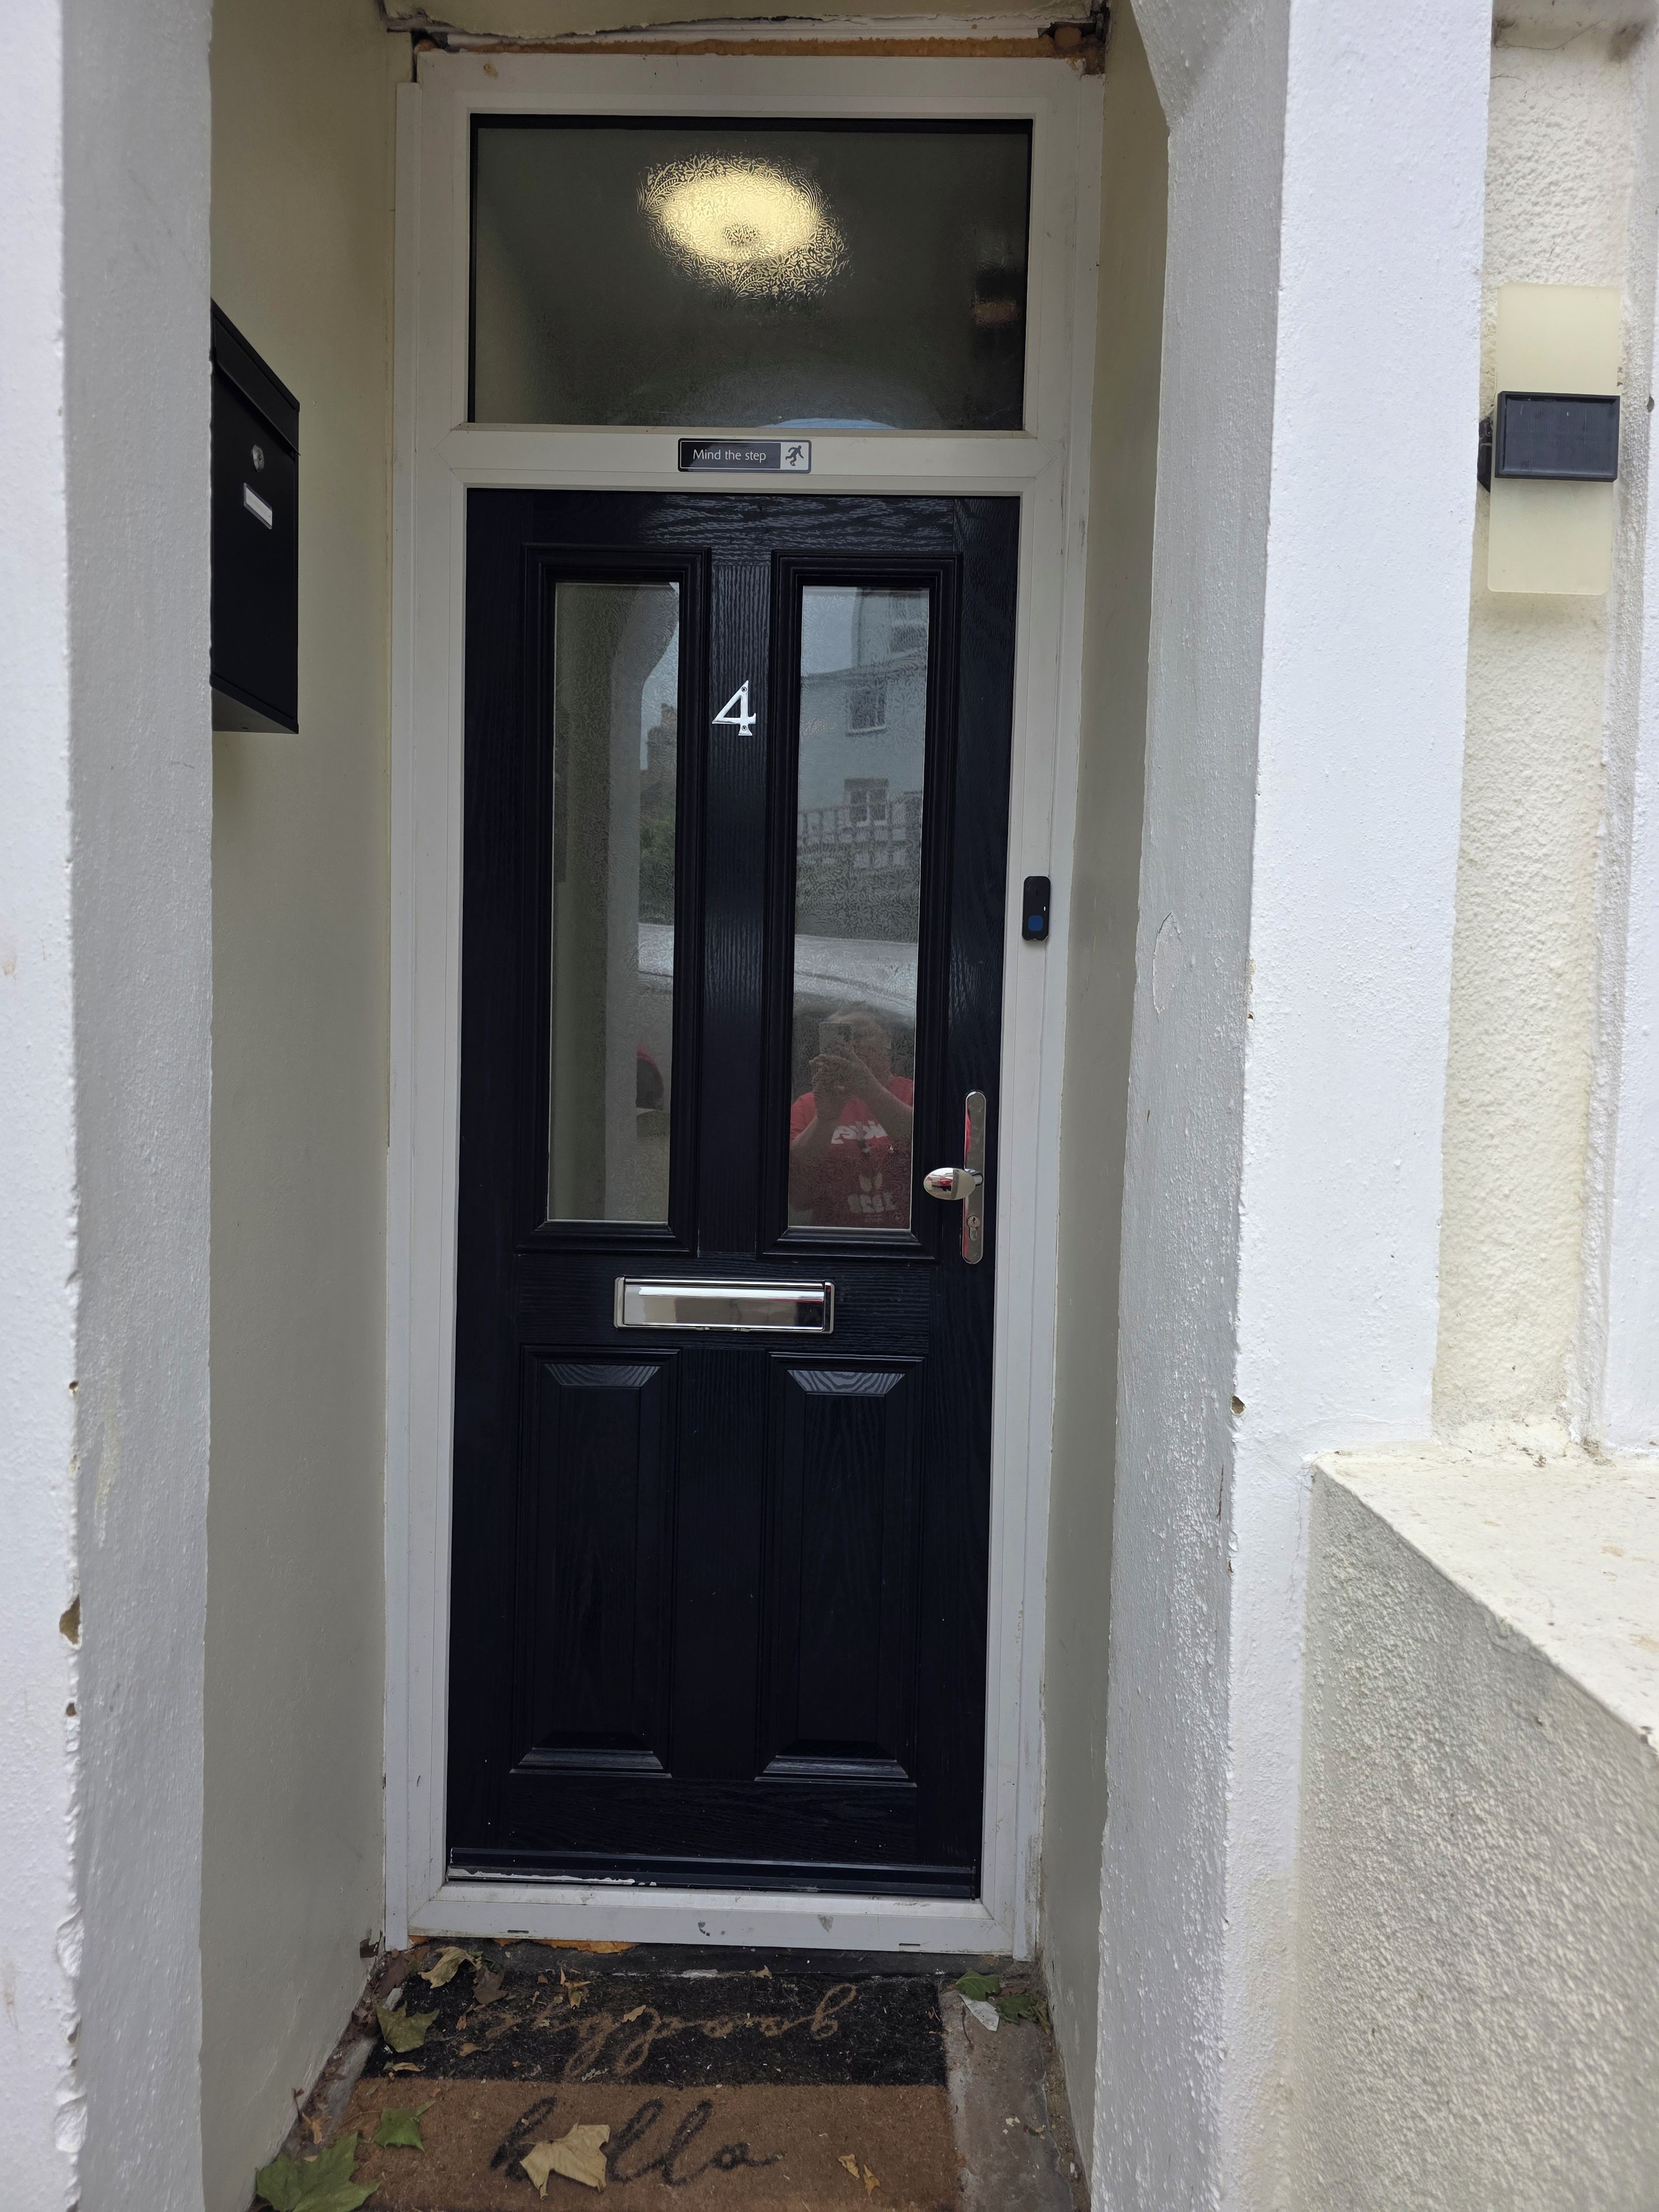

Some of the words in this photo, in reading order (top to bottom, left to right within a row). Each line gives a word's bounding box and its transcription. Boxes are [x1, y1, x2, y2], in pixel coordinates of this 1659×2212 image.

[693, 449, 721, 460] Mind
[725, 449, 741, 460] the
[745, 451, 766, 463] step
[711, 680, 756, 736] 4
[490, 2096, 786, 2186] hllo
